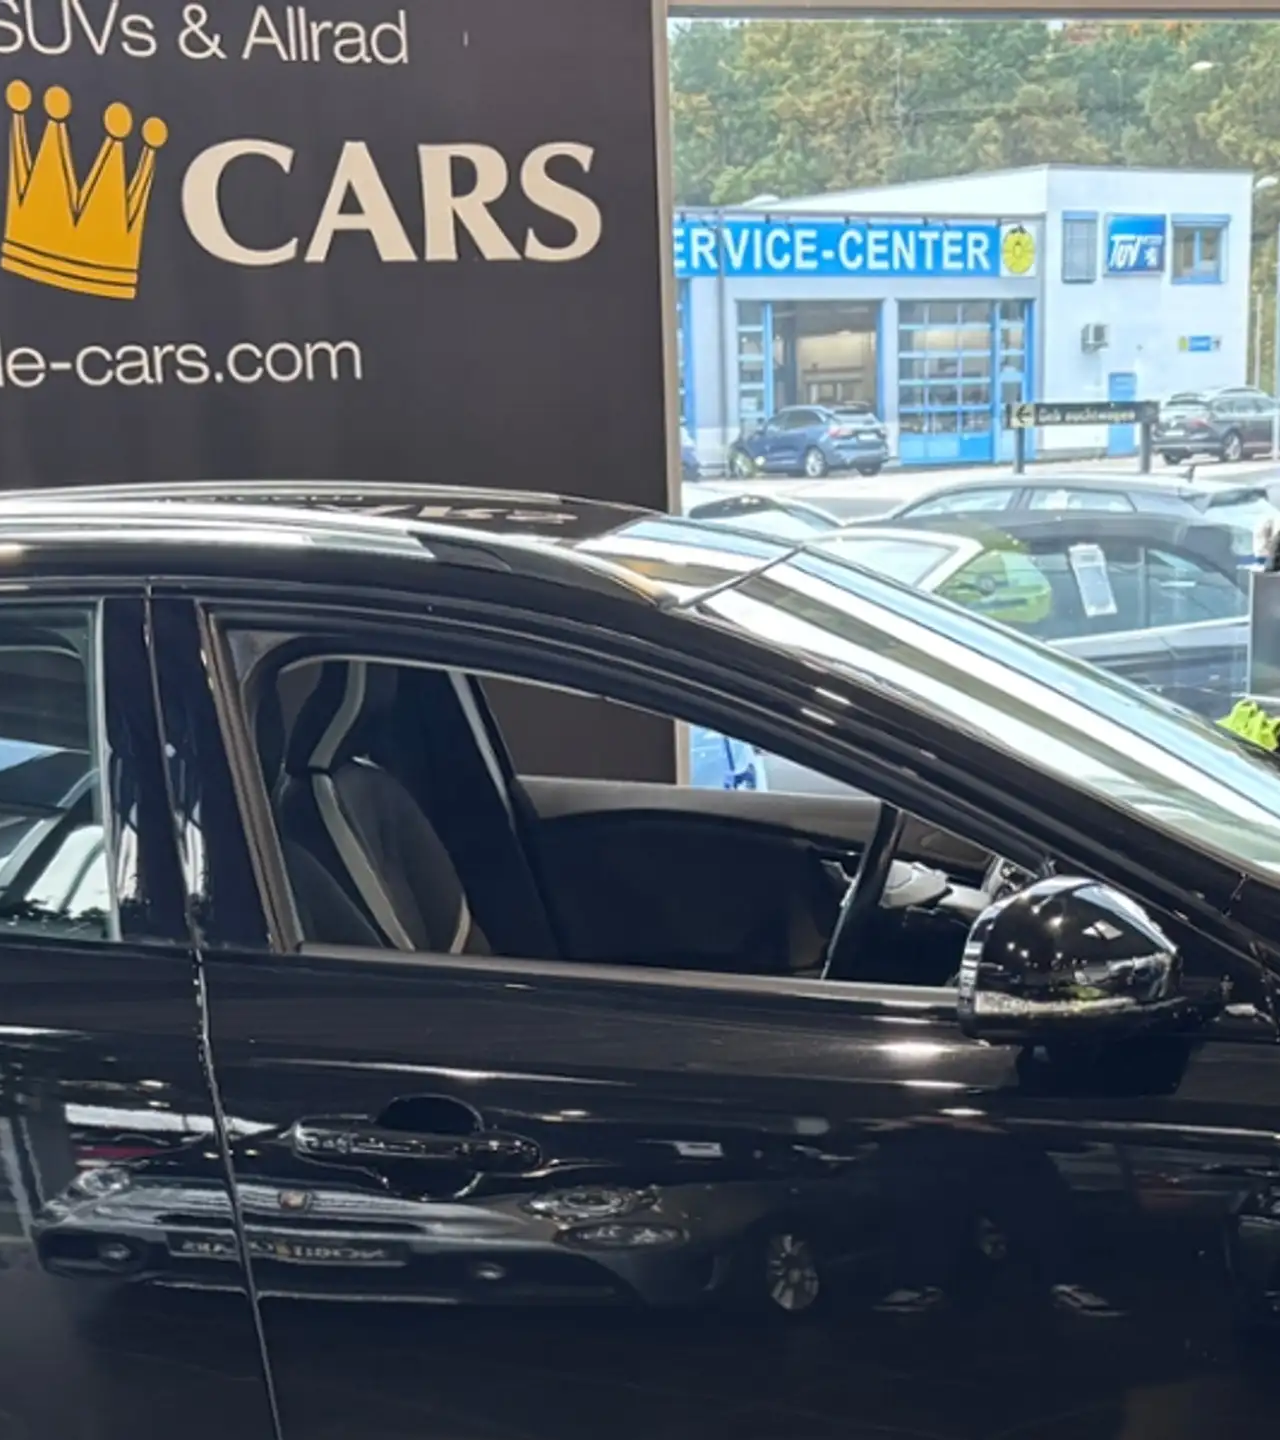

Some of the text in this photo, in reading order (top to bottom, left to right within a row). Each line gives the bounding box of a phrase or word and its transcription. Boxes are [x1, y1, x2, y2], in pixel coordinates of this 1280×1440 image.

[178, 3, 227, 59] &
[241, 5, 409, 64] Allrad
[181, 138, 602, 266] CARS
